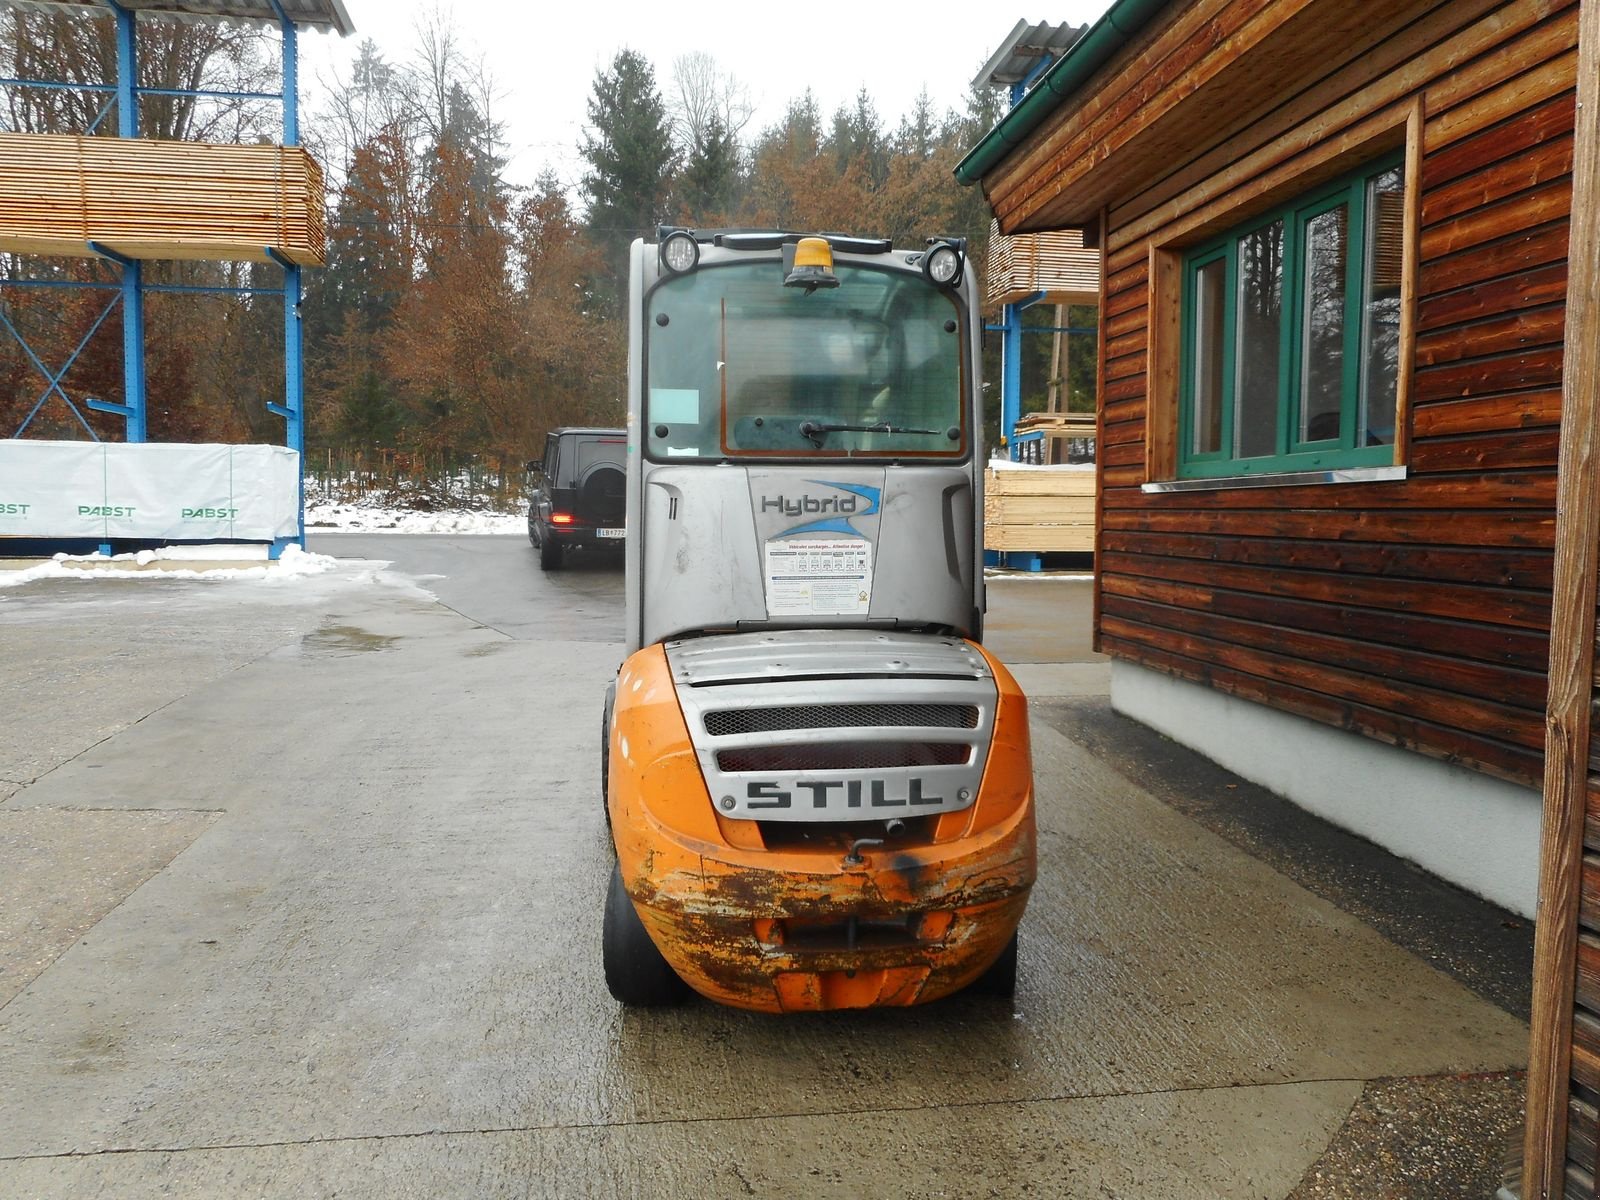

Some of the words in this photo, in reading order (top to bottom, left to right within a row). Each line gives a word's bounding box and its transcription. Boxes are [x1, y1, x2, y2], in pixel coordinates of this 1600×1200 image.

[78, 506, 136, 517] PABST
[182, 509, 238, 518] PABST
[762, 495, 856, 516] Hybrid
[747, 779, 943, 808] STILL
